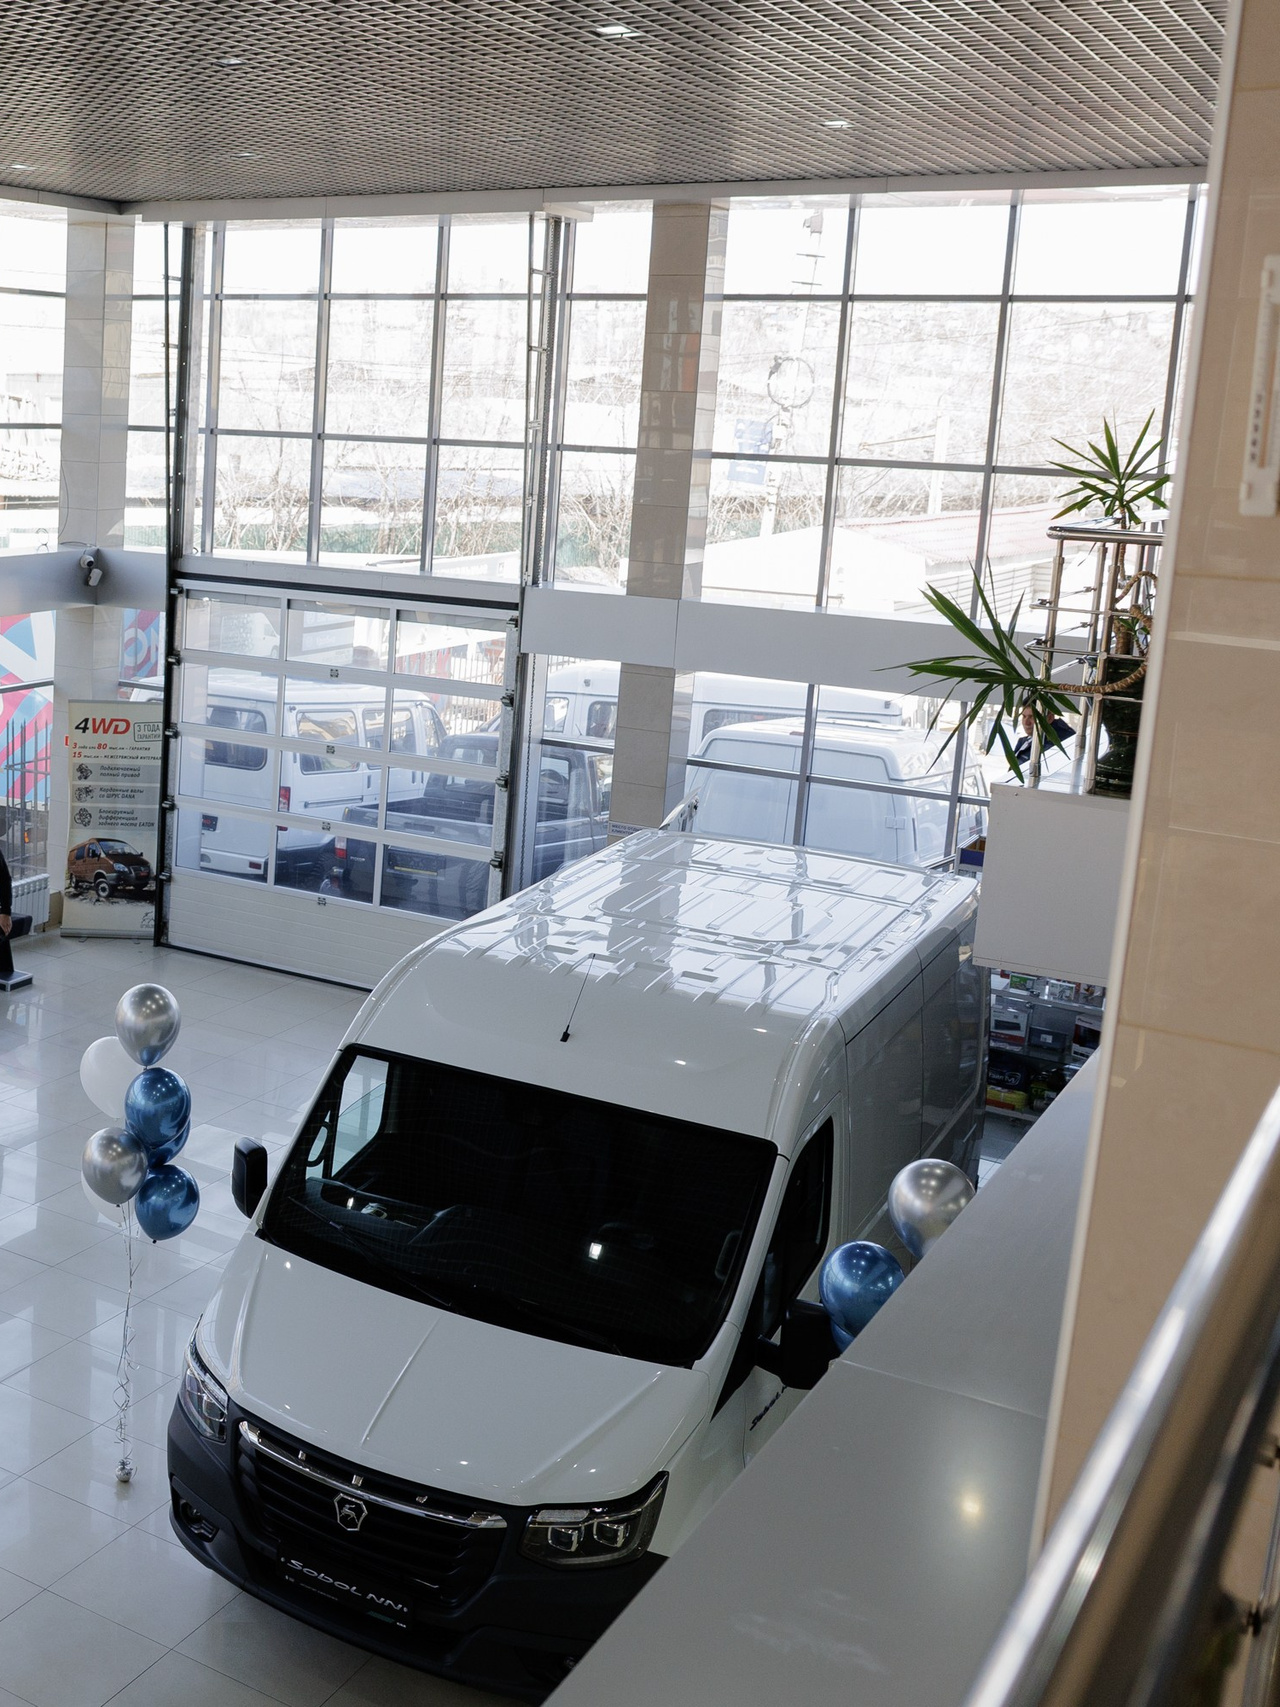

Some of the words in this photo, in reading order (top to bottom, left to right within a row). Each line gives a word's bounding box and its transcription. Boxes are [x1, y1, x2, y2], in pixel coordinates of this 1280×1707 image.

[74, 717, 131, 735] 4WD
[136, 724, 142, 732] 3
[143, 724, 160, 732] ГОДА
[365, 1593, 403, 1611] NN
